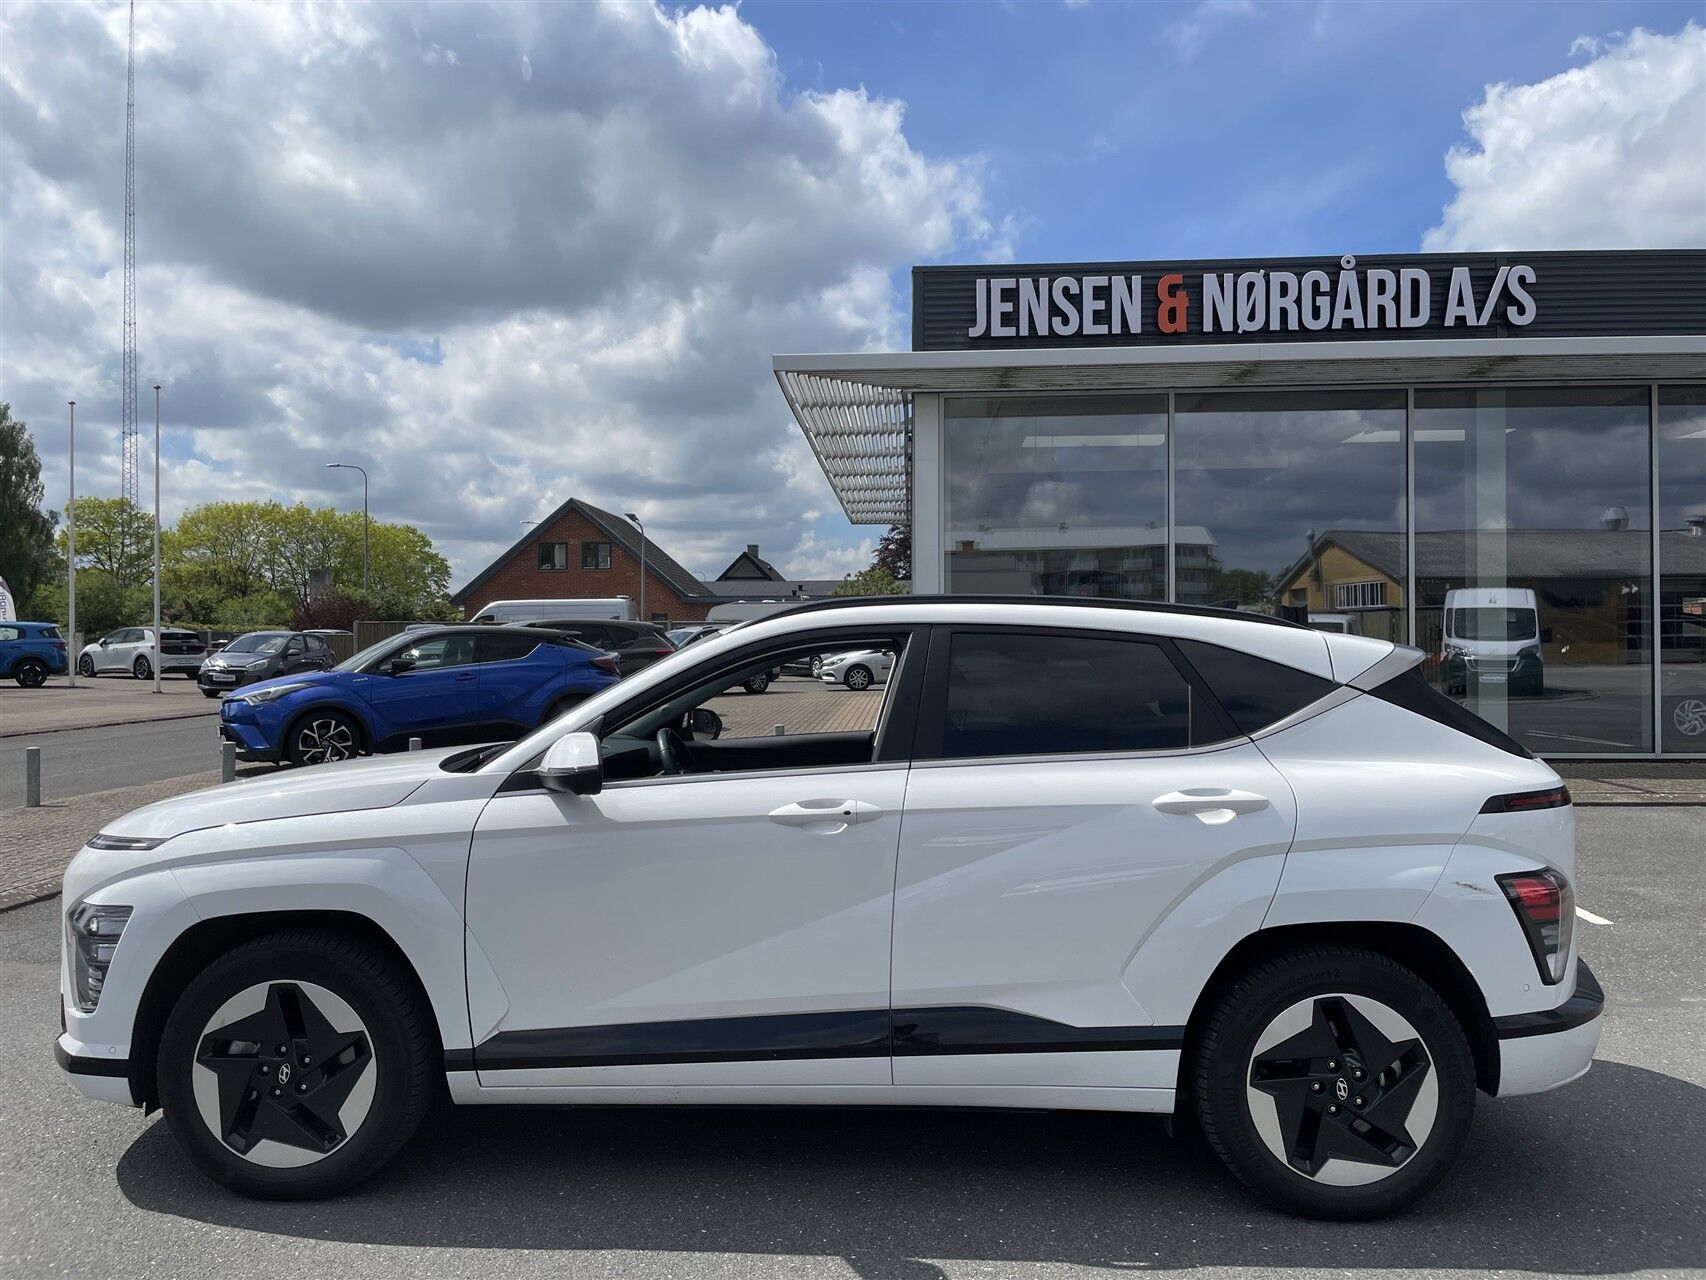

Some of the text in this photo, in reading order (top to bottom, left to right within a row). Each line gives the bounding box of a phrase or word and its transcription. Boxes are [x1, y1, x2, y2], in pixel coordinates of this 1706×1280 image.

[968, 254, 1537, 338] JENSEN & NØRGÅRD A/S
